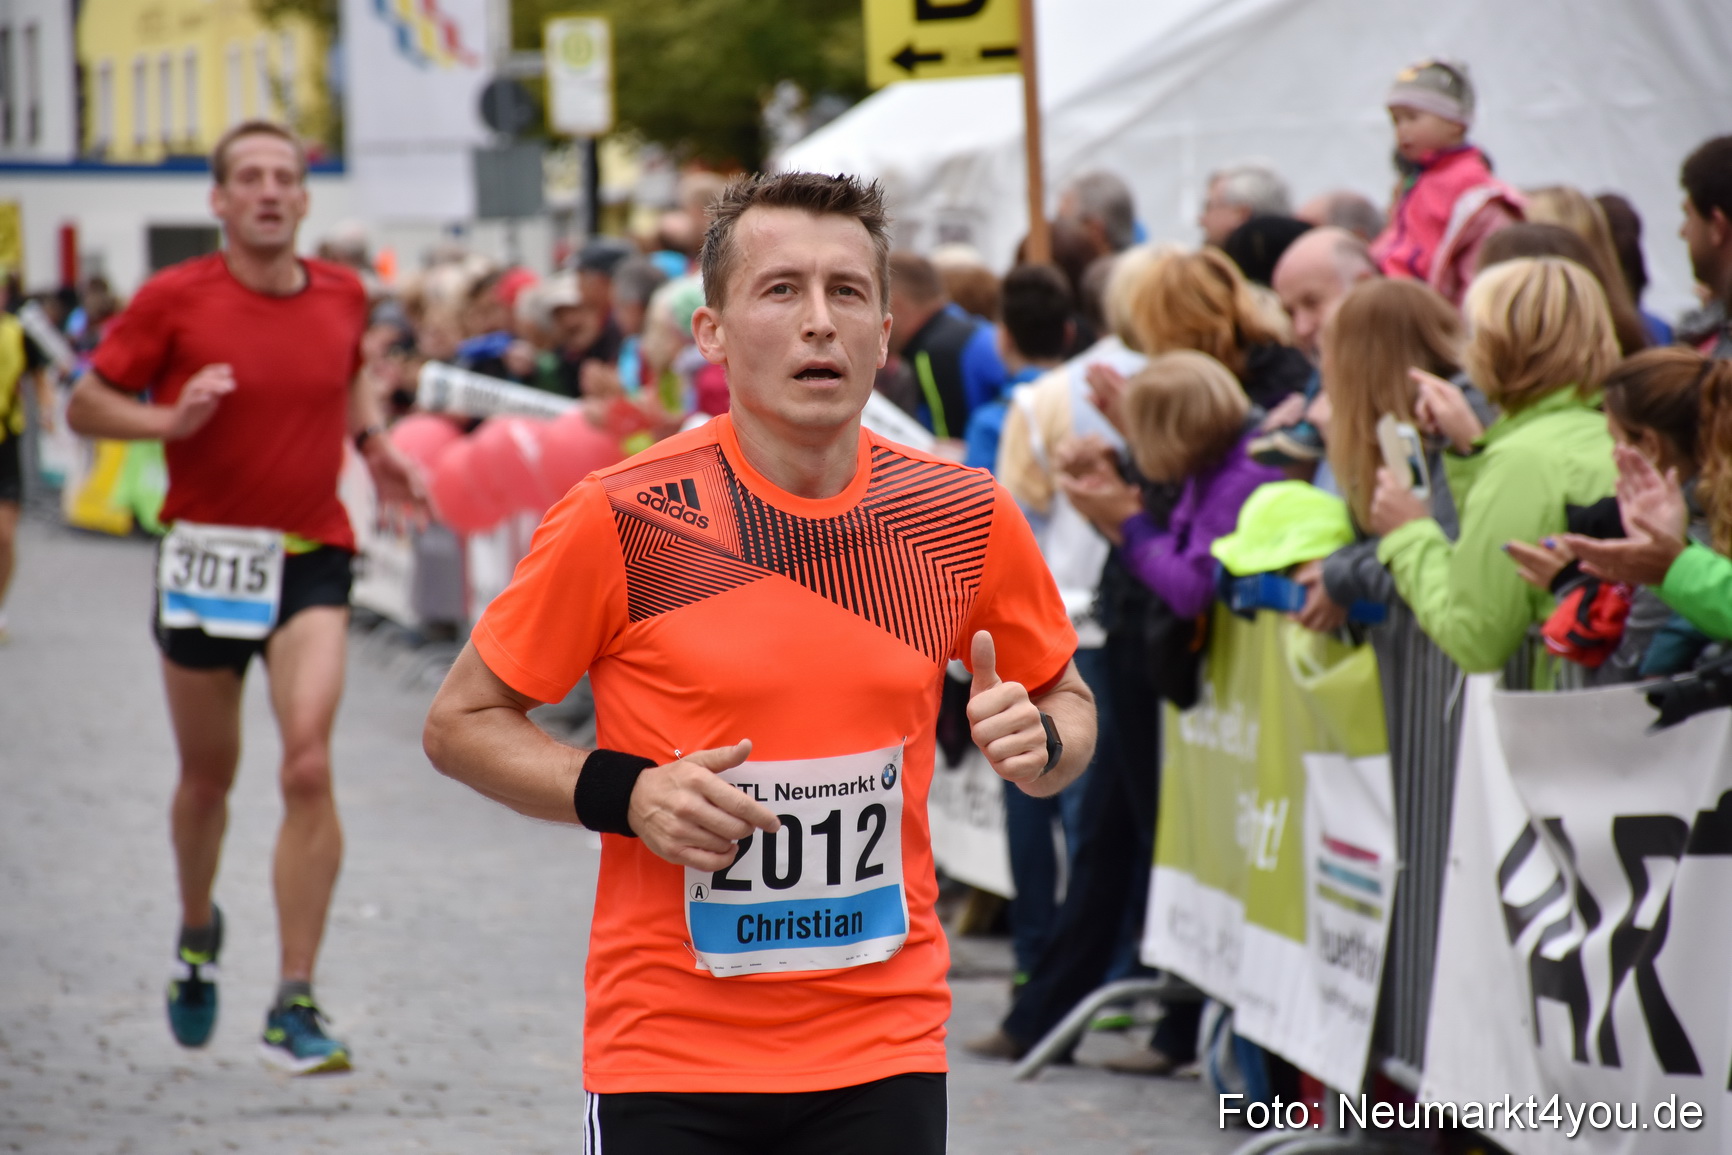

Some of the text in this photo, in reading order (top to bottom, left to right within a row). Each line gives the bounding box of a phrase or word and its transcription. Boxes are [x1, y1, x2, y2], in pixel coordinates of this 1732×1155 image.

[636, 491, 709, 529] adidas
[172, 546, 268, 594] 3015
[728, 775, 876, 802] TL Neumarkt
[711, 803, 887, 891] 2012
[695, 885, 703, 899] A
[736, 909, 863, 944] Christian
